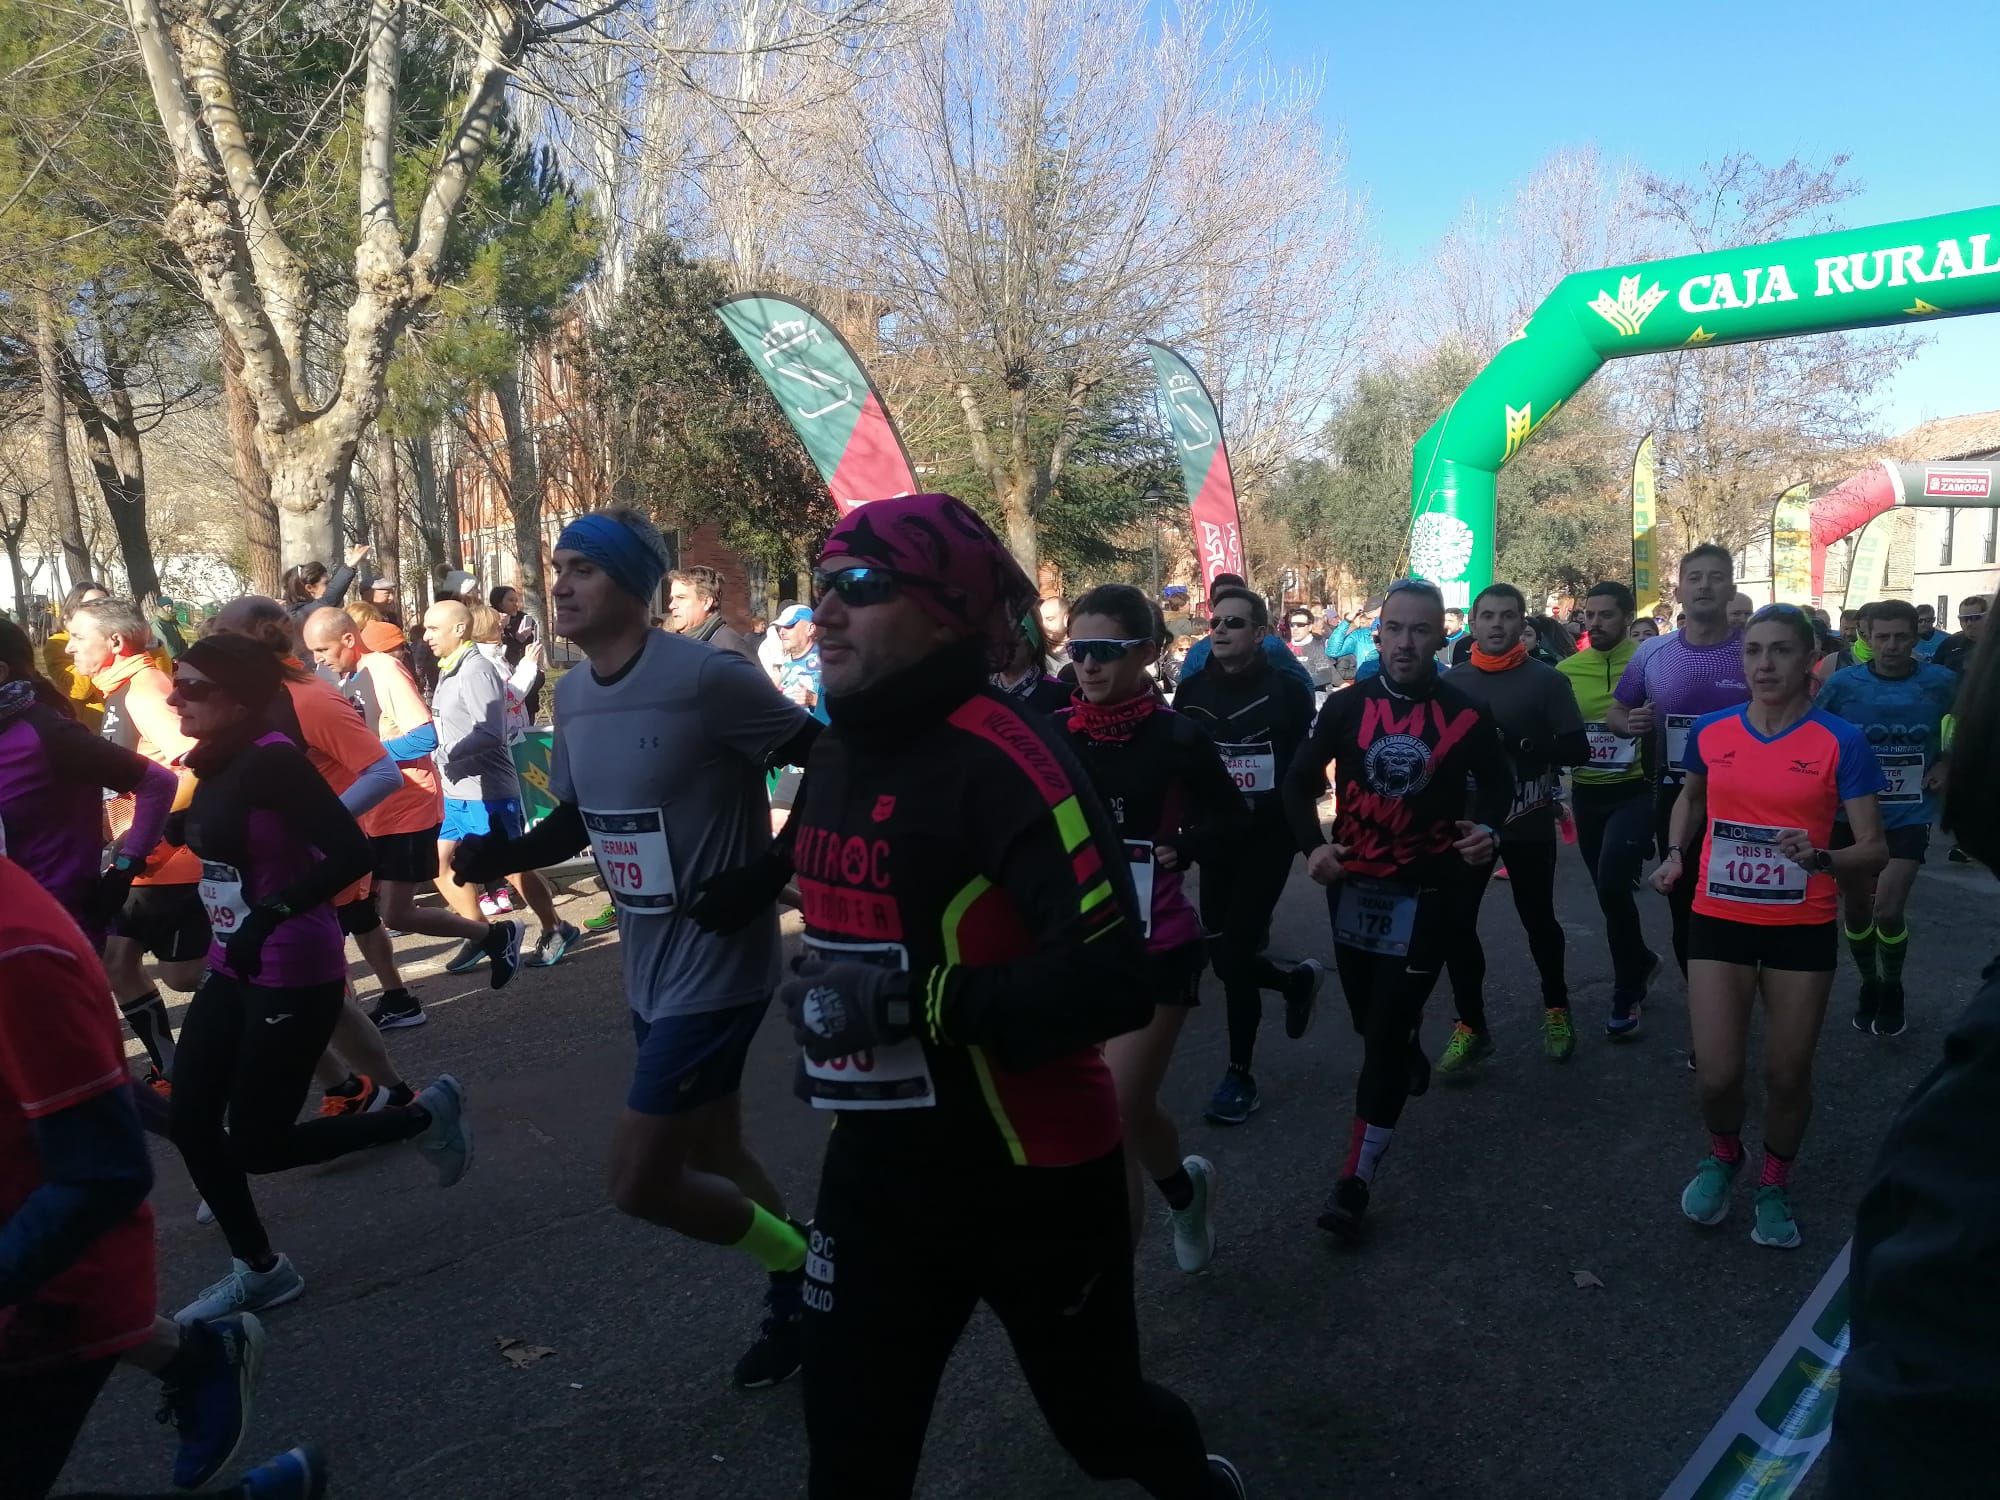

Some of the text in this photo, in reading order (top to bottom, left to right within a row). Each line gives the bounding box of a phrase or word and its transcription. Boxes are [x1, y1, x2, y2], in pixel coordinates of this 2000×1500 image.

[1678, 233, 2000, 313] CAJA RURAL
[1940, 483, 1986, 492] ZAMORA
[1357, 697, 1480, 768] MY
[1590, 735, 1615, 744] LUCHO
[1736, 845, 1776, 859] CRIS B.
[607, 860, 643, 890] 879
[1725, 860, 1786, 885] 1021
[1357, 911, 1393, 936] 178
